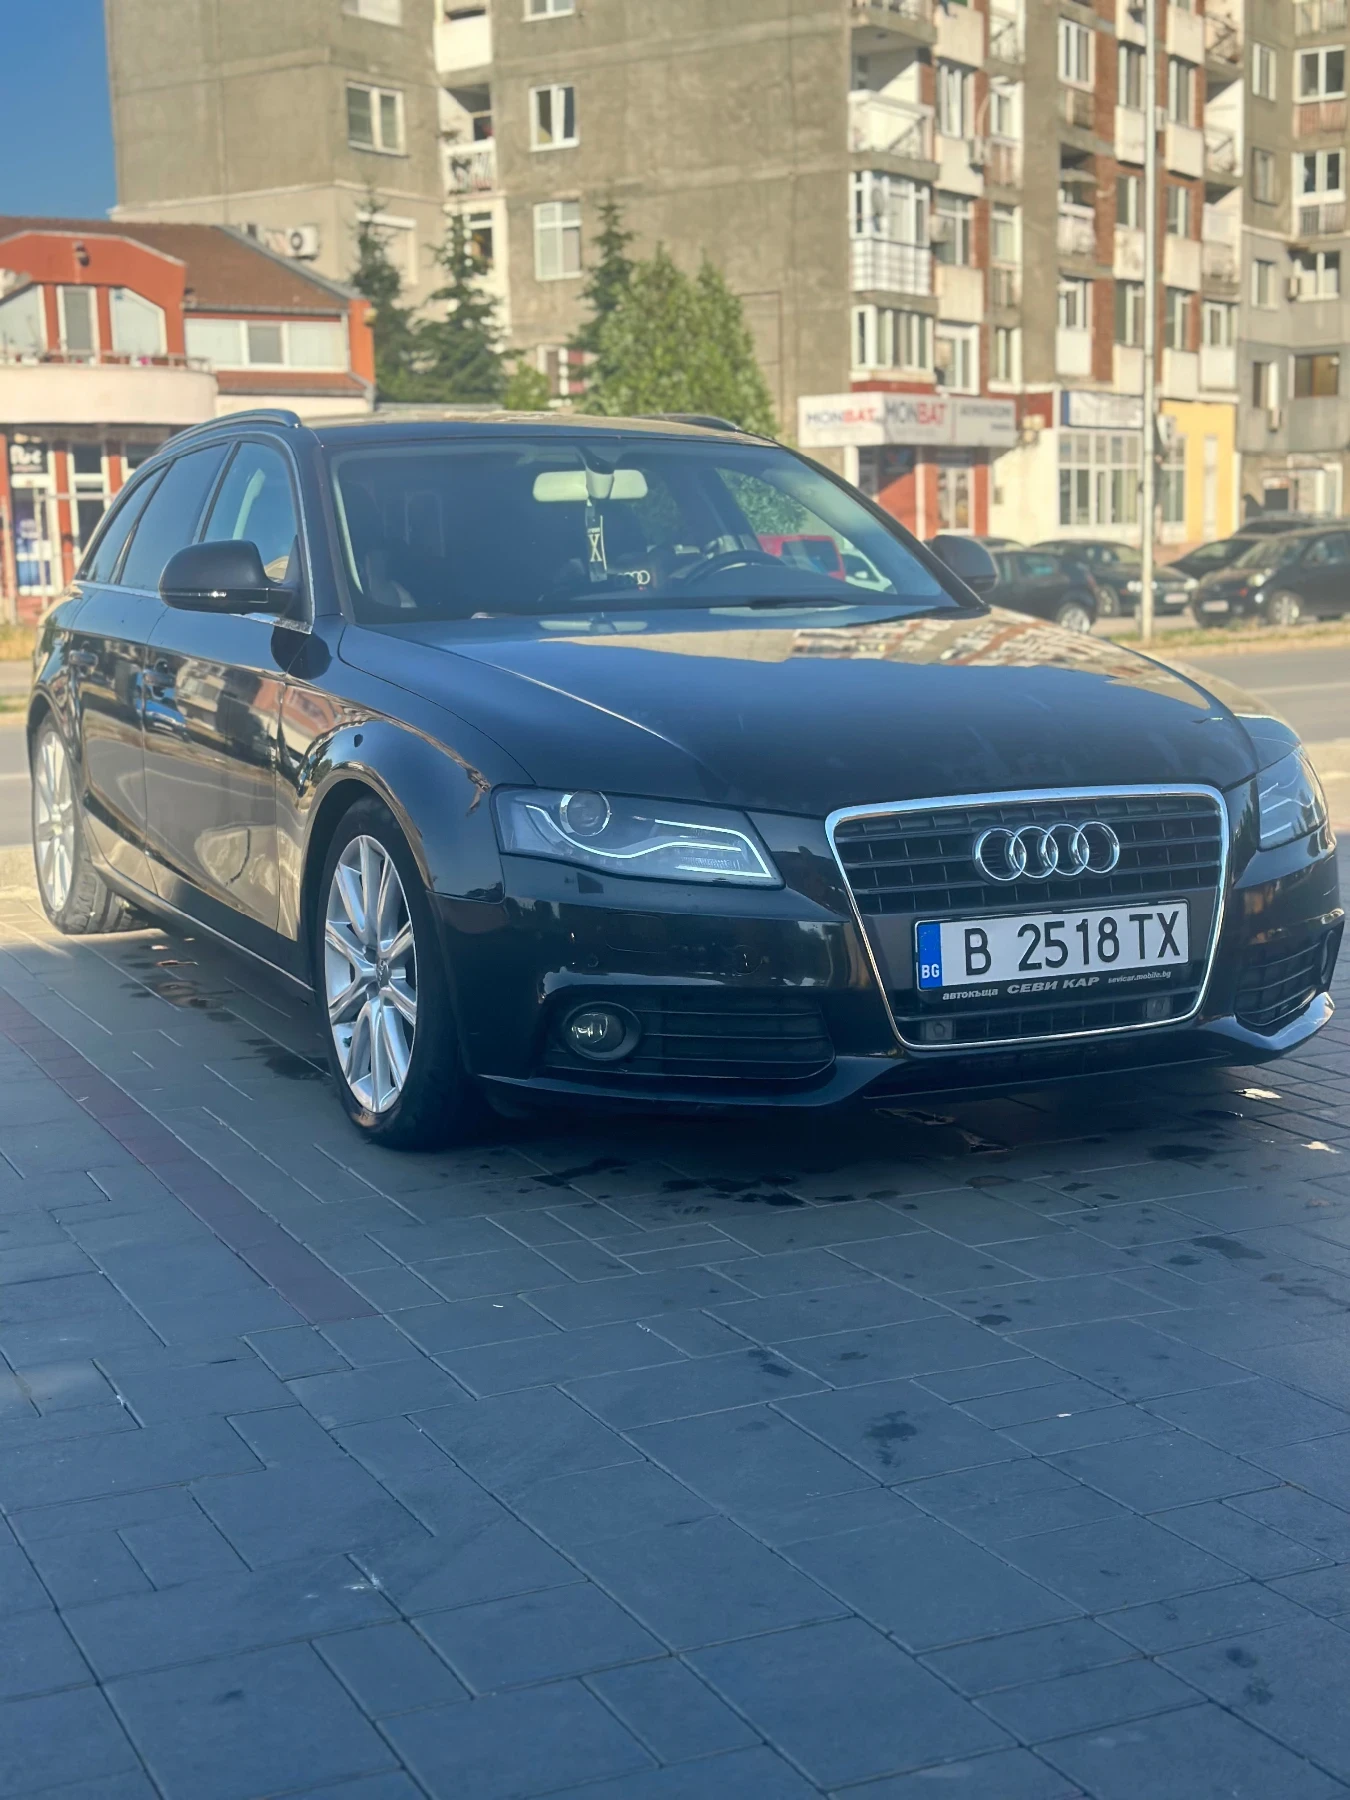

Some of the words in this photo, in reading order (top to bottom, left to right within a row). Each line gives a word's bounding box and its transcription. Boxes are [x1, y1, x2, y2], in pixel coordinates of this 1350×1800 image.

[806, 407, 876, 425] MONBAT
[886, 401, 946, 424] MONBAT
[964, 927, 992, 976] B
[1017, 916, 1120, 972] 2518
[1129, 911, 1181, 960] TX
[921, 963, 940, 979] BG
[1107, 970, 1172, 984] sevicar.mobile.bg
[942, 988, 999, 1001] автокъща
[1007, 980, 1060, 994] СЕВИ
[1062, 976, 1100, 989] КАР
